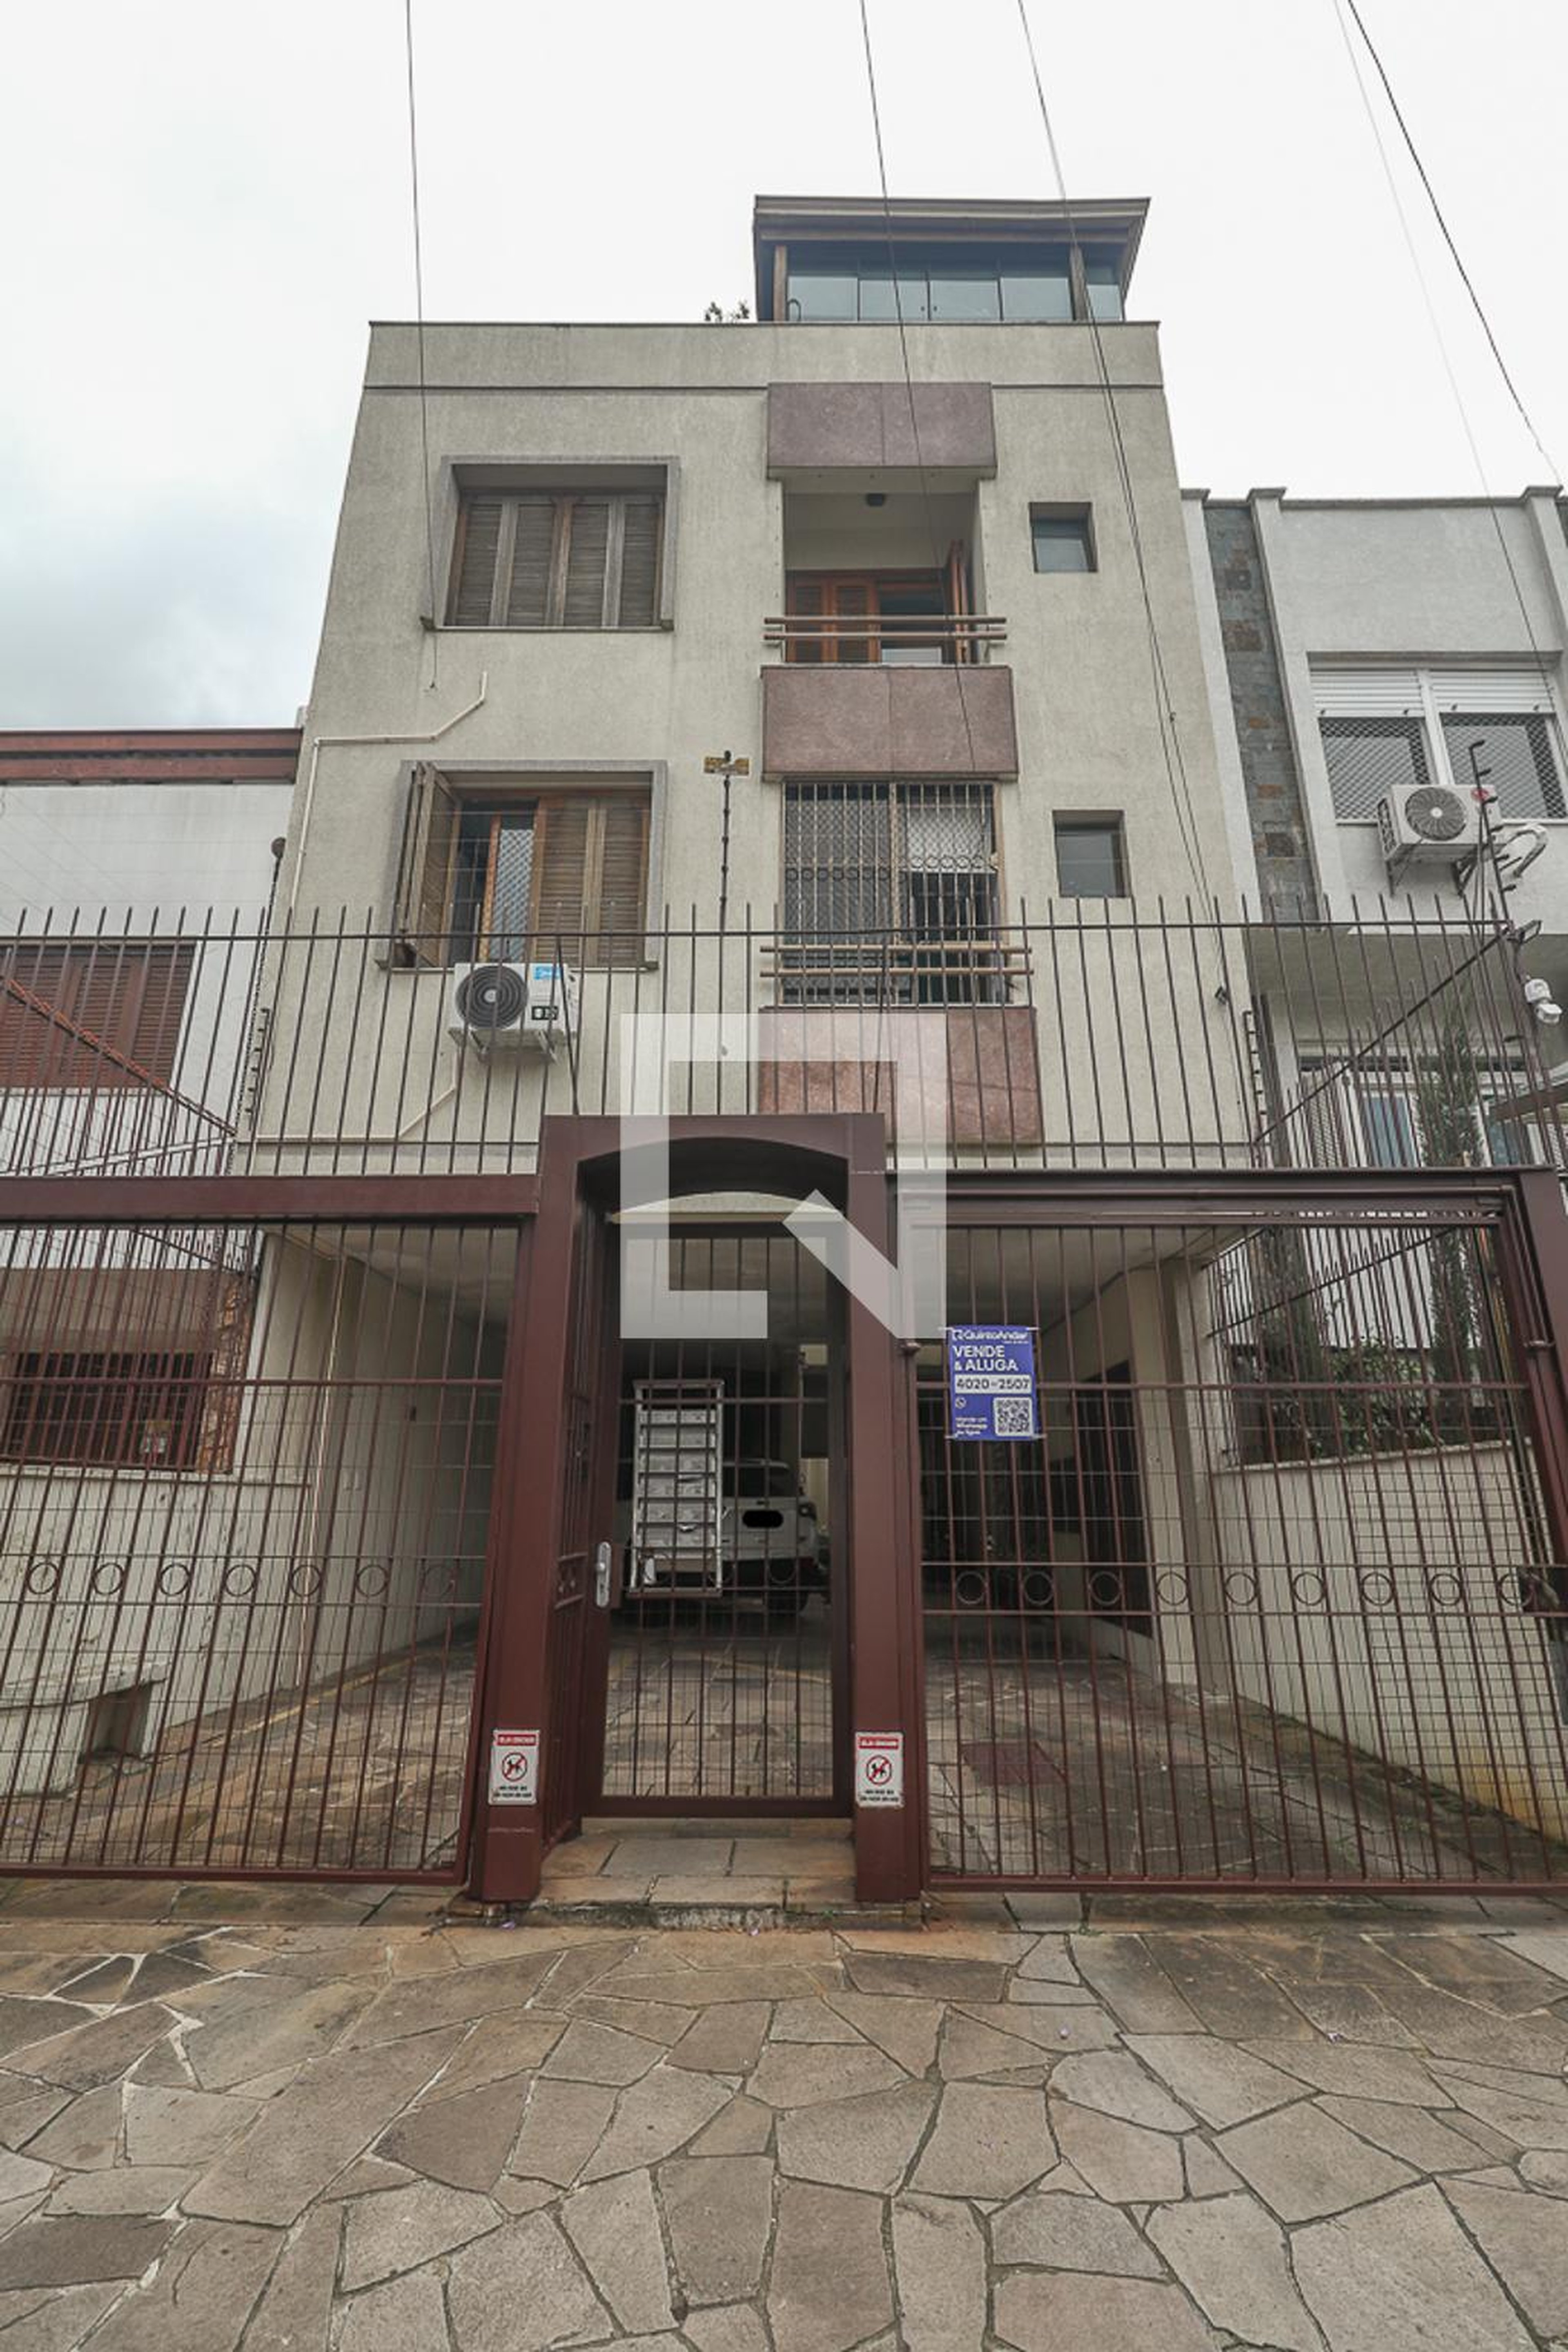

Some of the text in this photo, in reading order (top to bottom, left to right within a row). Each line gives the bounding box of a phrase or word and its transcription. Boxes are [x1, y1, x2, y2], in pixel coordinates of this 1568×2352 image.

[953, 1345, 1005, 1358] VENDE
[954, 1359, 1019, 1372] & ALUGA
[956, 1377, 1029, 1390] 4020-2507
